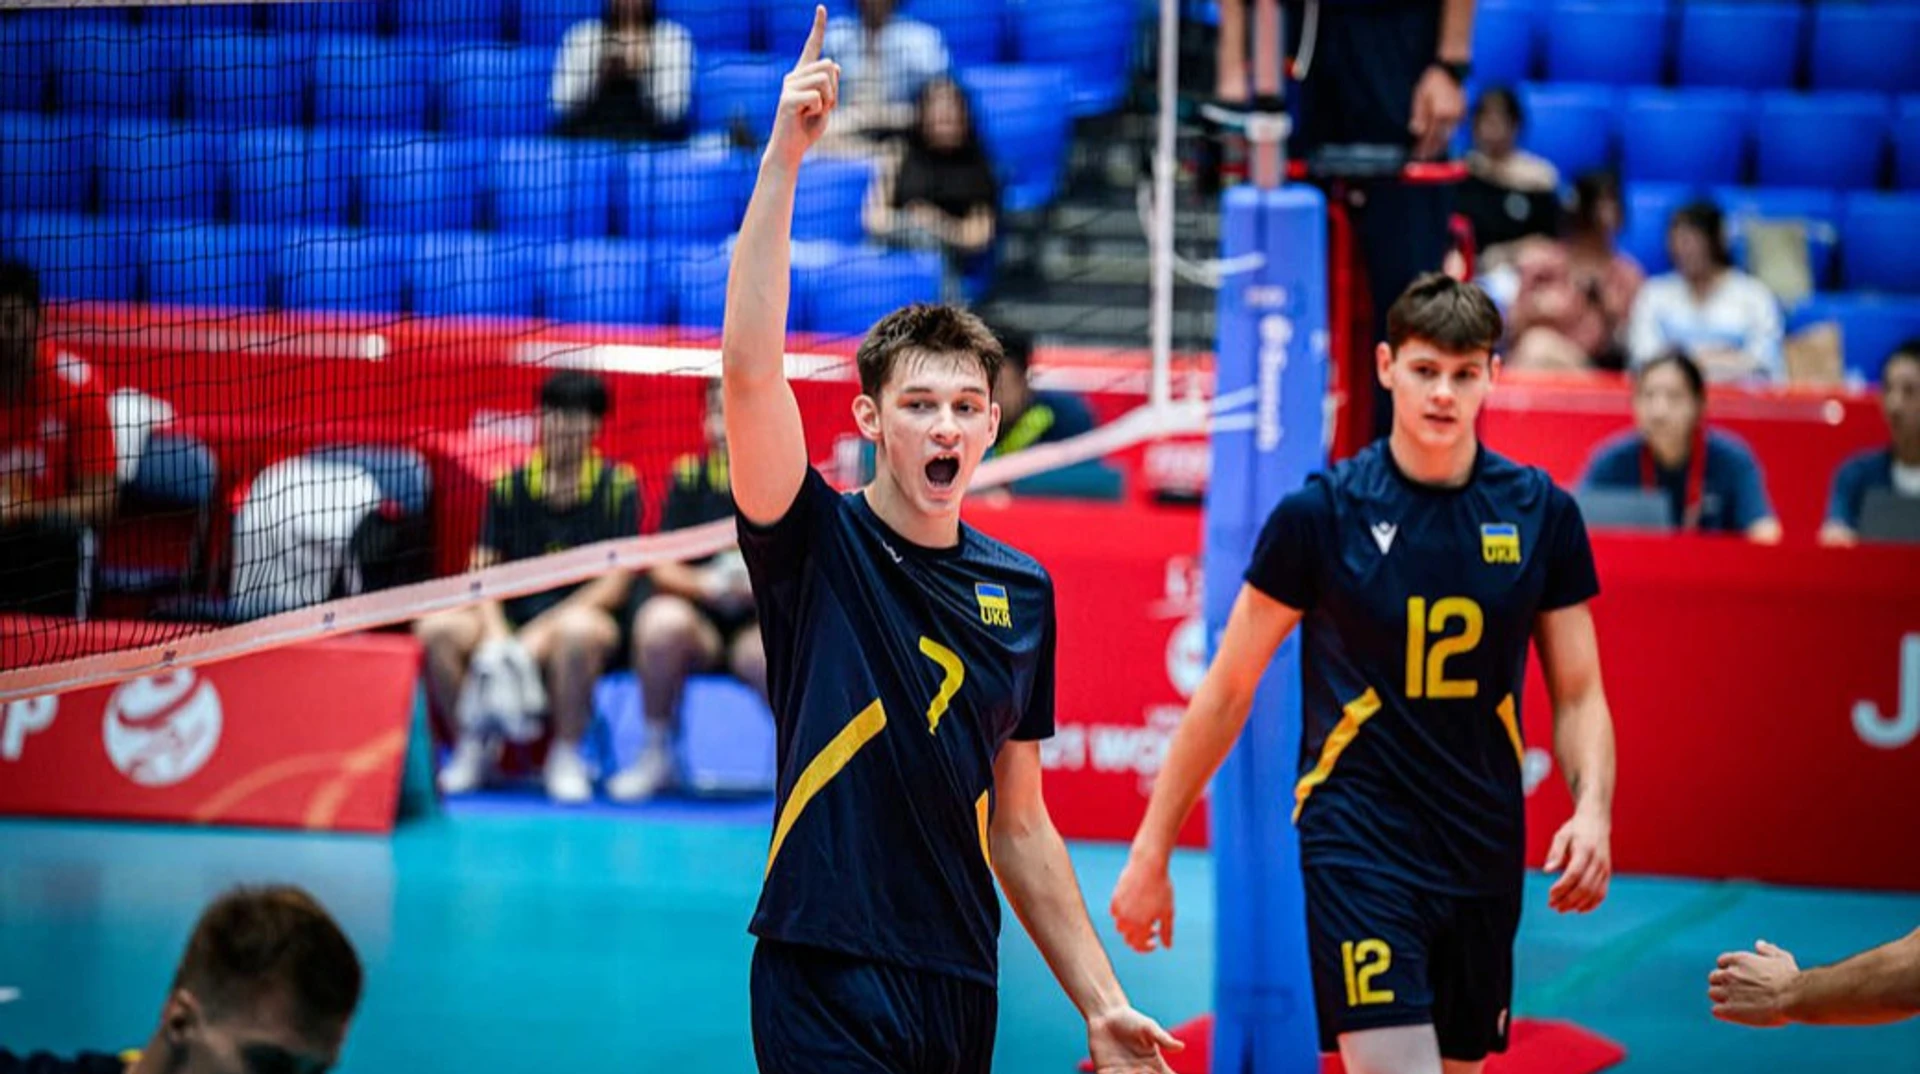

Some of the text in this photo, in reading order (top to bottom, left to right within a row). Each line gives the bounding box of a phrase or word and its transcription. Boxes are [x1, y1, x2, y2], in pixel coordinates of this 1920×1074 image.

[980, 605, 1012, 629] UKR
[1405, 596, 1484, 699] 12
[918, 634, 965, 735] 7
[1341, 937, 1395, 1007] 12
